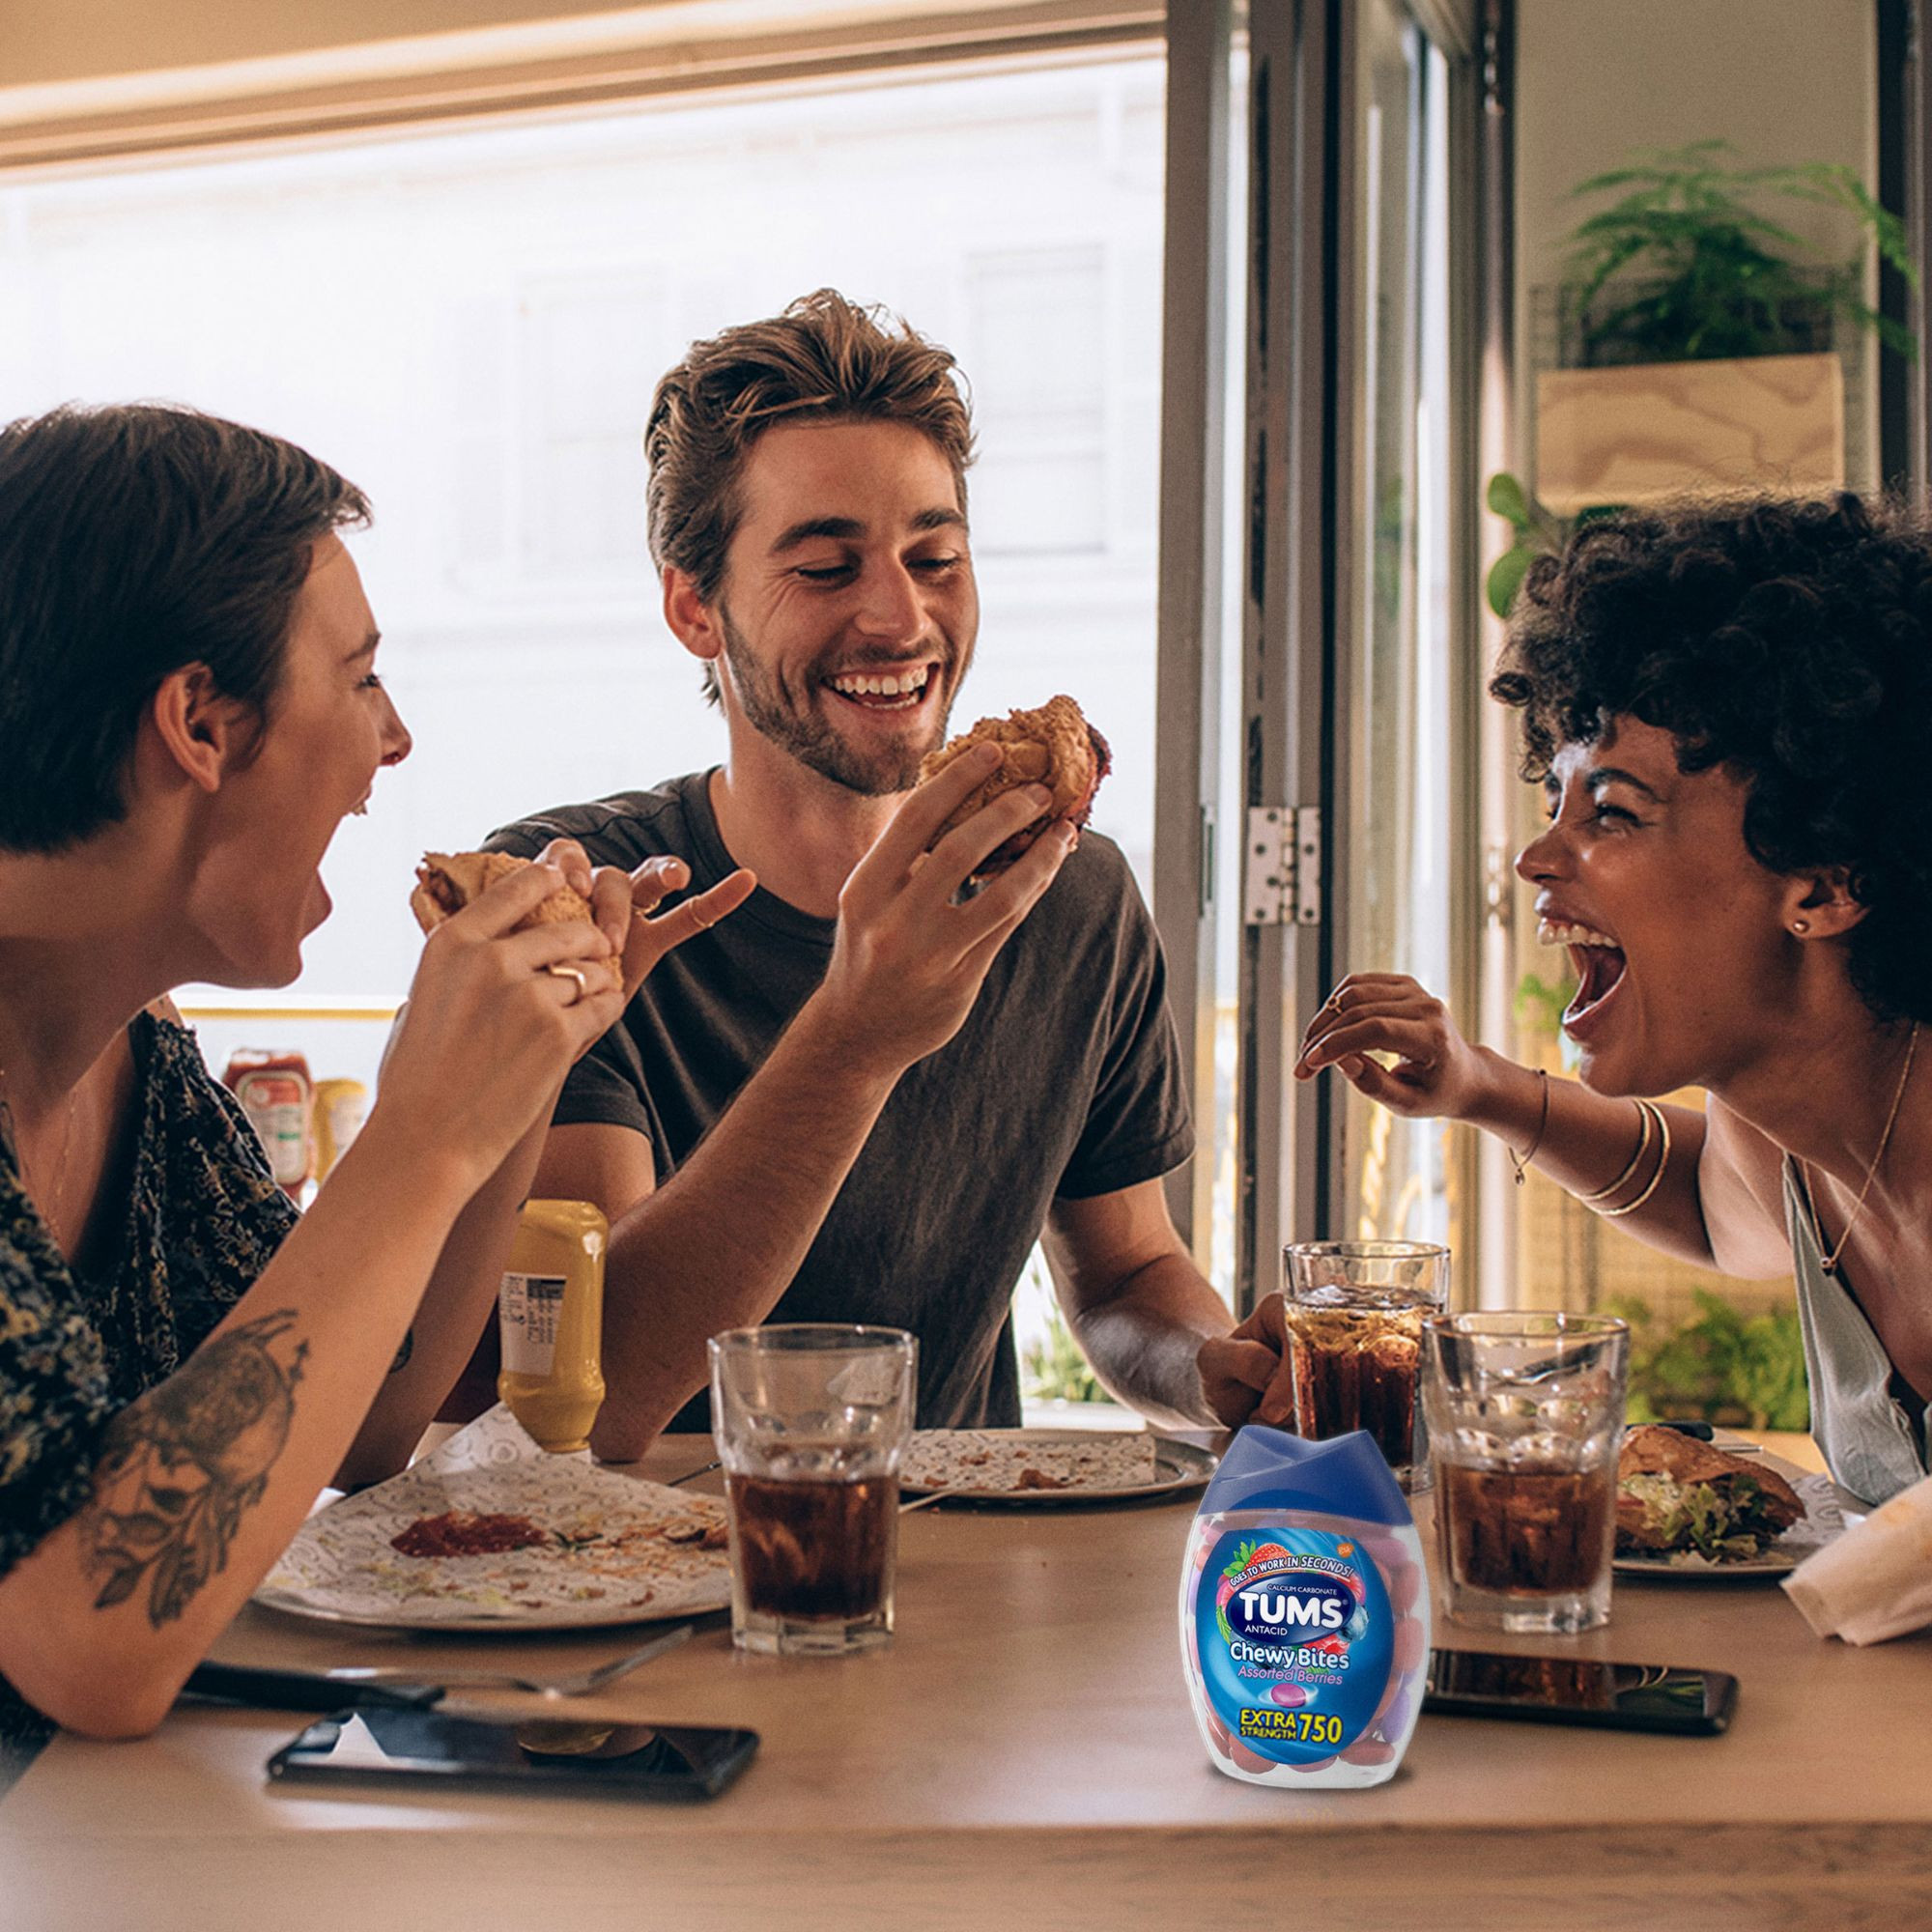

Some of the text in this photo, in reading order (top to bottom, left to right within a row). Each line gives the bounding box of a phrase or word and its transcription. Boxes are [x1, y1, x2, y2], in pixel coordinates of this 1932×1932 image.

[1231, 1557, 1354, 1586] GOES TO WORK IN SECONDS!
[1267, 1584, 1337, 1595] CALCIUM CARBONATE
[1245, 1625, 1288, 1635] ANTACID
[1231, 1642, 1350, 1669] Chewy Bites
[1237, 1665, 1343, 1685] Assorted Berries
[1240, 1709, 1343, 1743] EXTRA 750
[1240, 1727, 1296, 1740] STRENGTH
